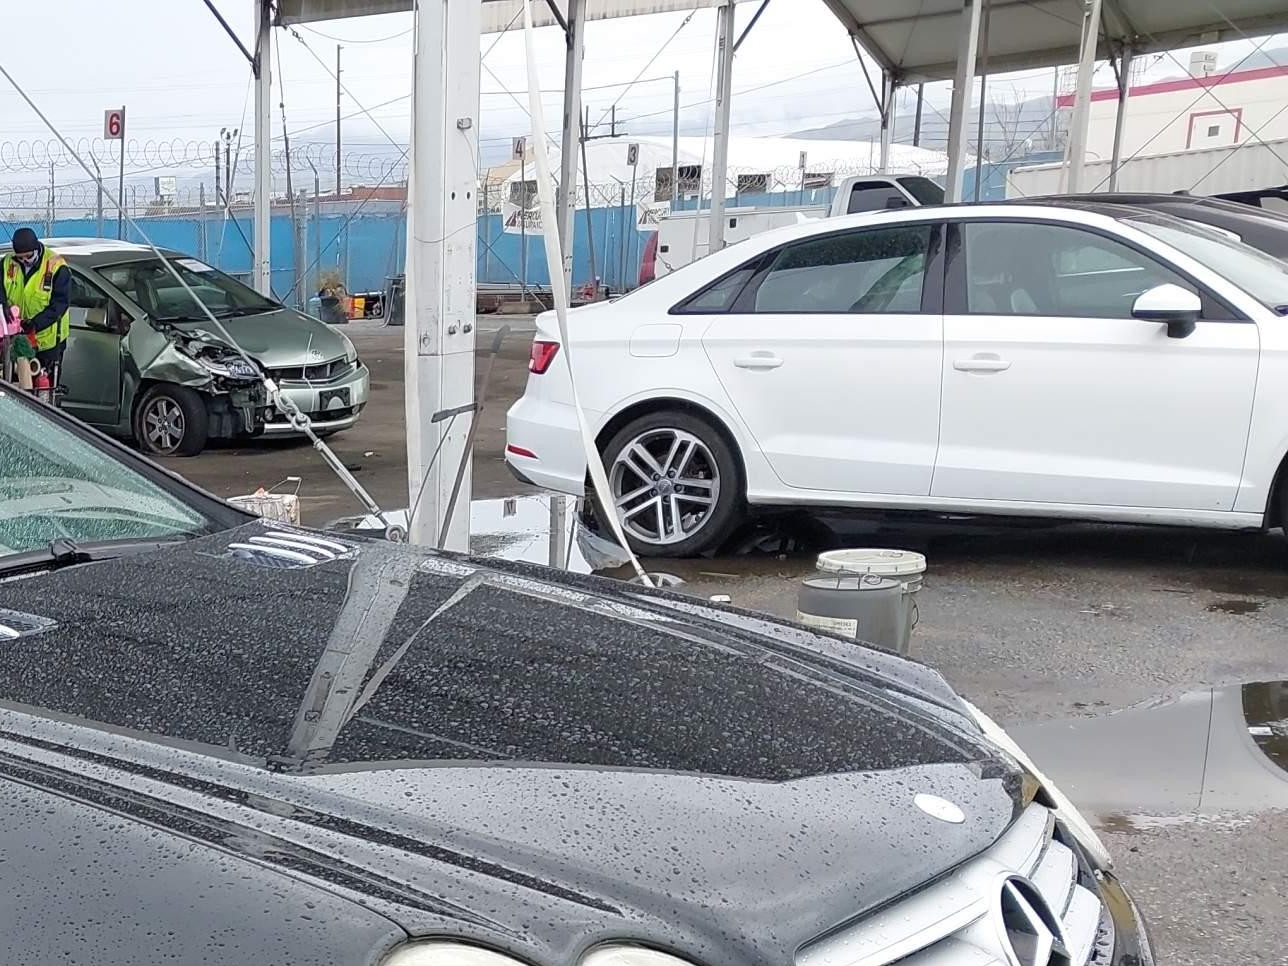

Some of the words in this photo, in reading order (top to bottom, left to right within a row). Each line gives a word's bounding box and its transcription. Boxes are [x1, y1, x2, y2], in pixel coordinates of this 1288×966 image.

[108, 112, 121, 136] 6
[514, 139, 523, 158] 4
[629, 146, 637, 163] 3
